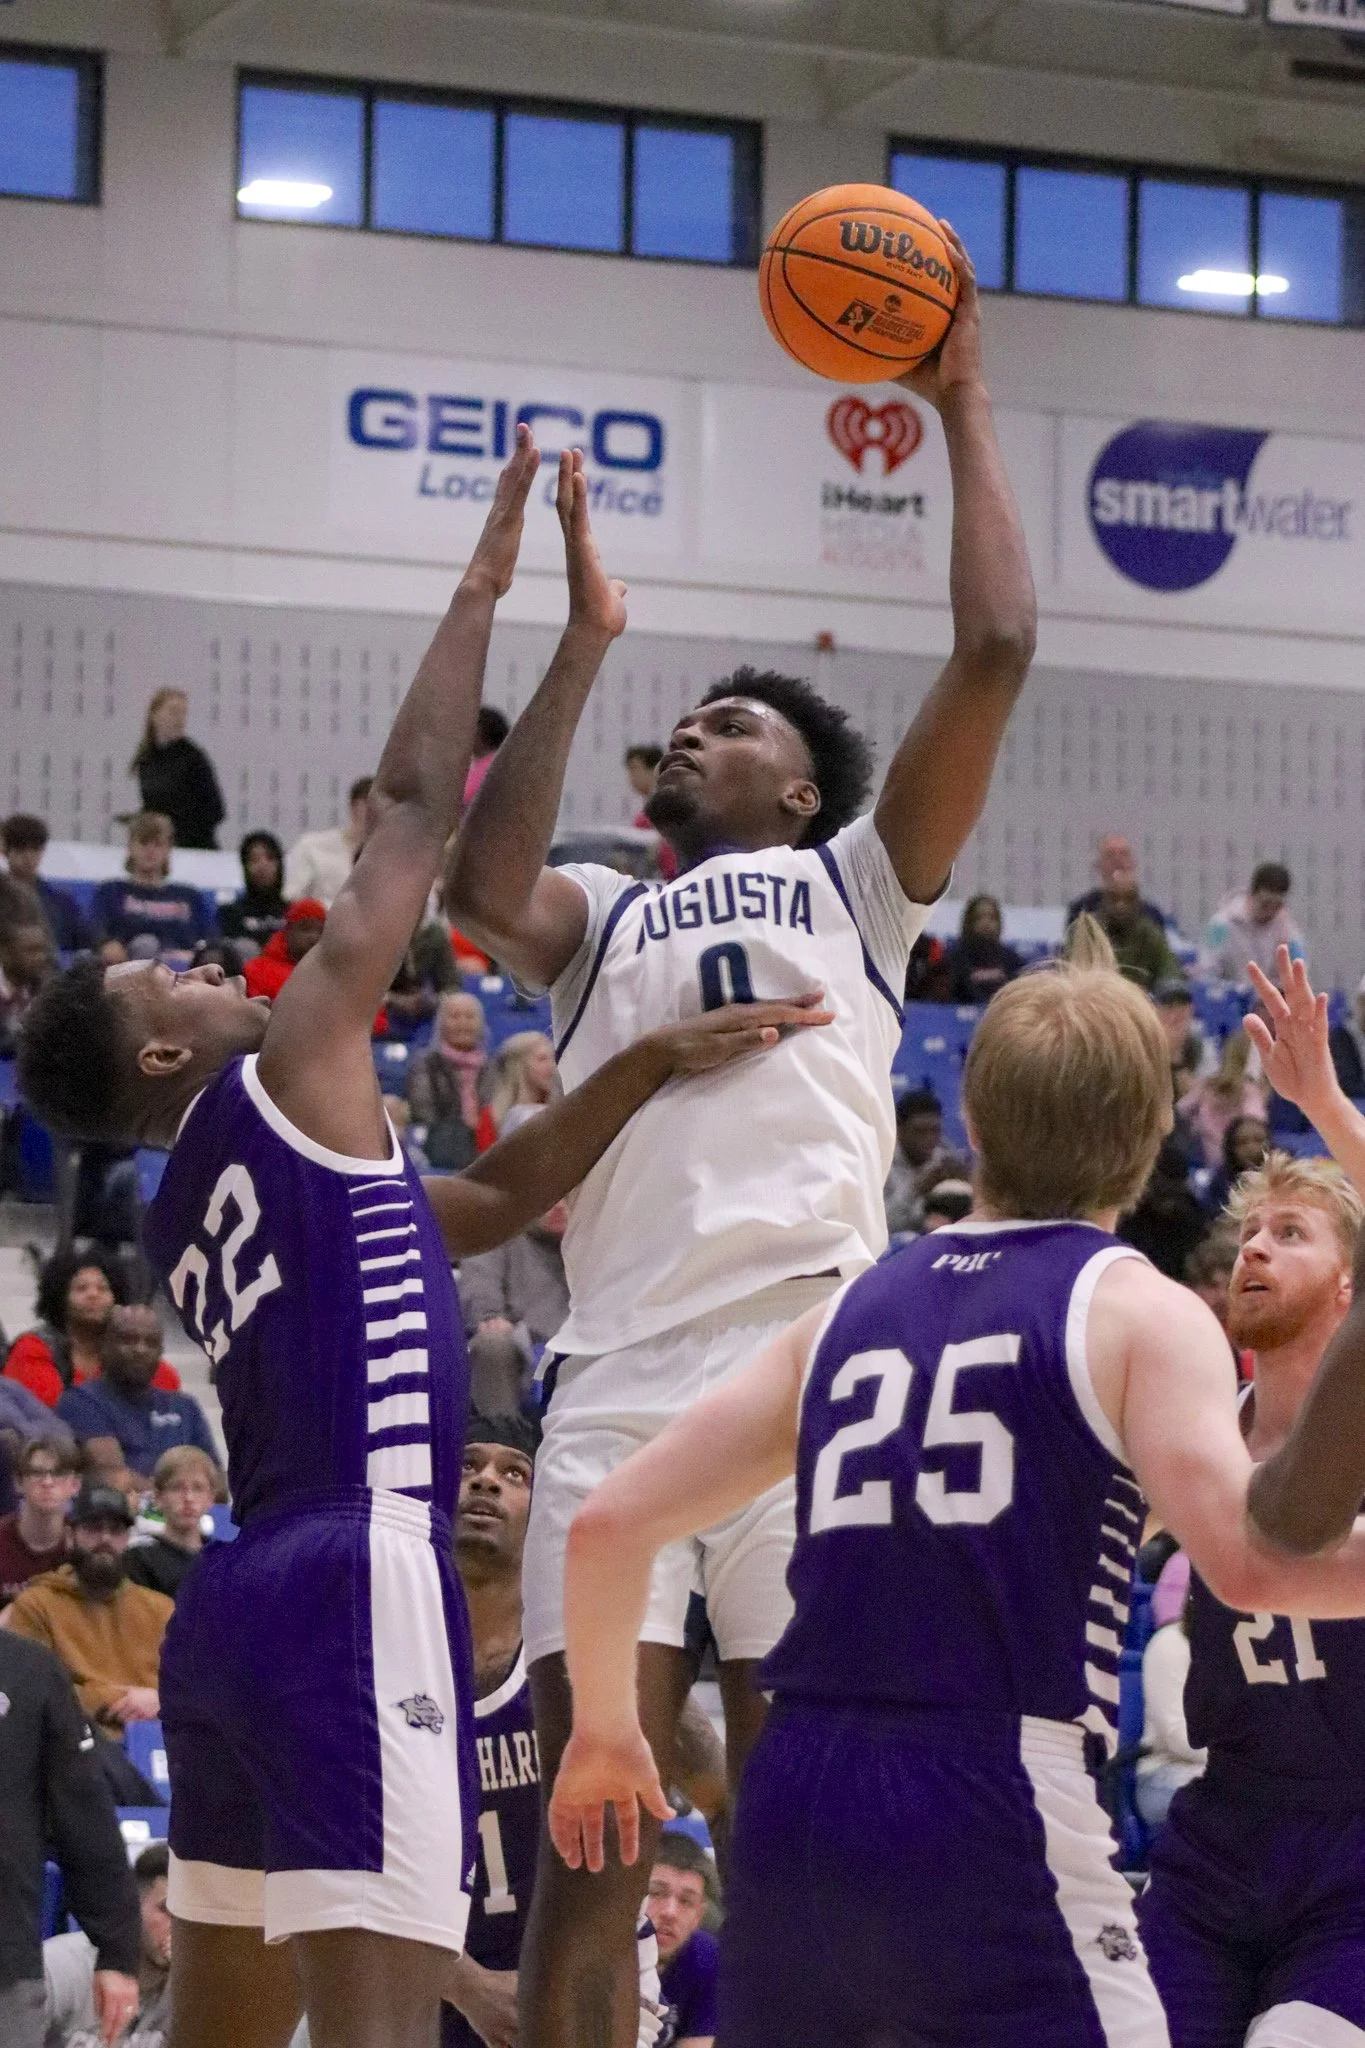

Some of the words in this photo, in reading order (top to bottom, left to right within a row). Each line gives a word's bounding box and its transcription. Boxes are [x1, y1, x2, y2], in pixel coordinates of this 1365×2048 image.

[840, 221, 952, 294] Wilson
[347, 386, 664, 472] GEICO
[417, 461, 496, 500] Loc
[821, 481, 924, 518] iHeart
[696, 940, 757, 1013] 0
[169, 1163, 282, 1364] 22
[809, 1333, 1021, 1535] 25
[1232, 1613, 1327, 1685] 21
[477, 1810, 517, 1914] 1
